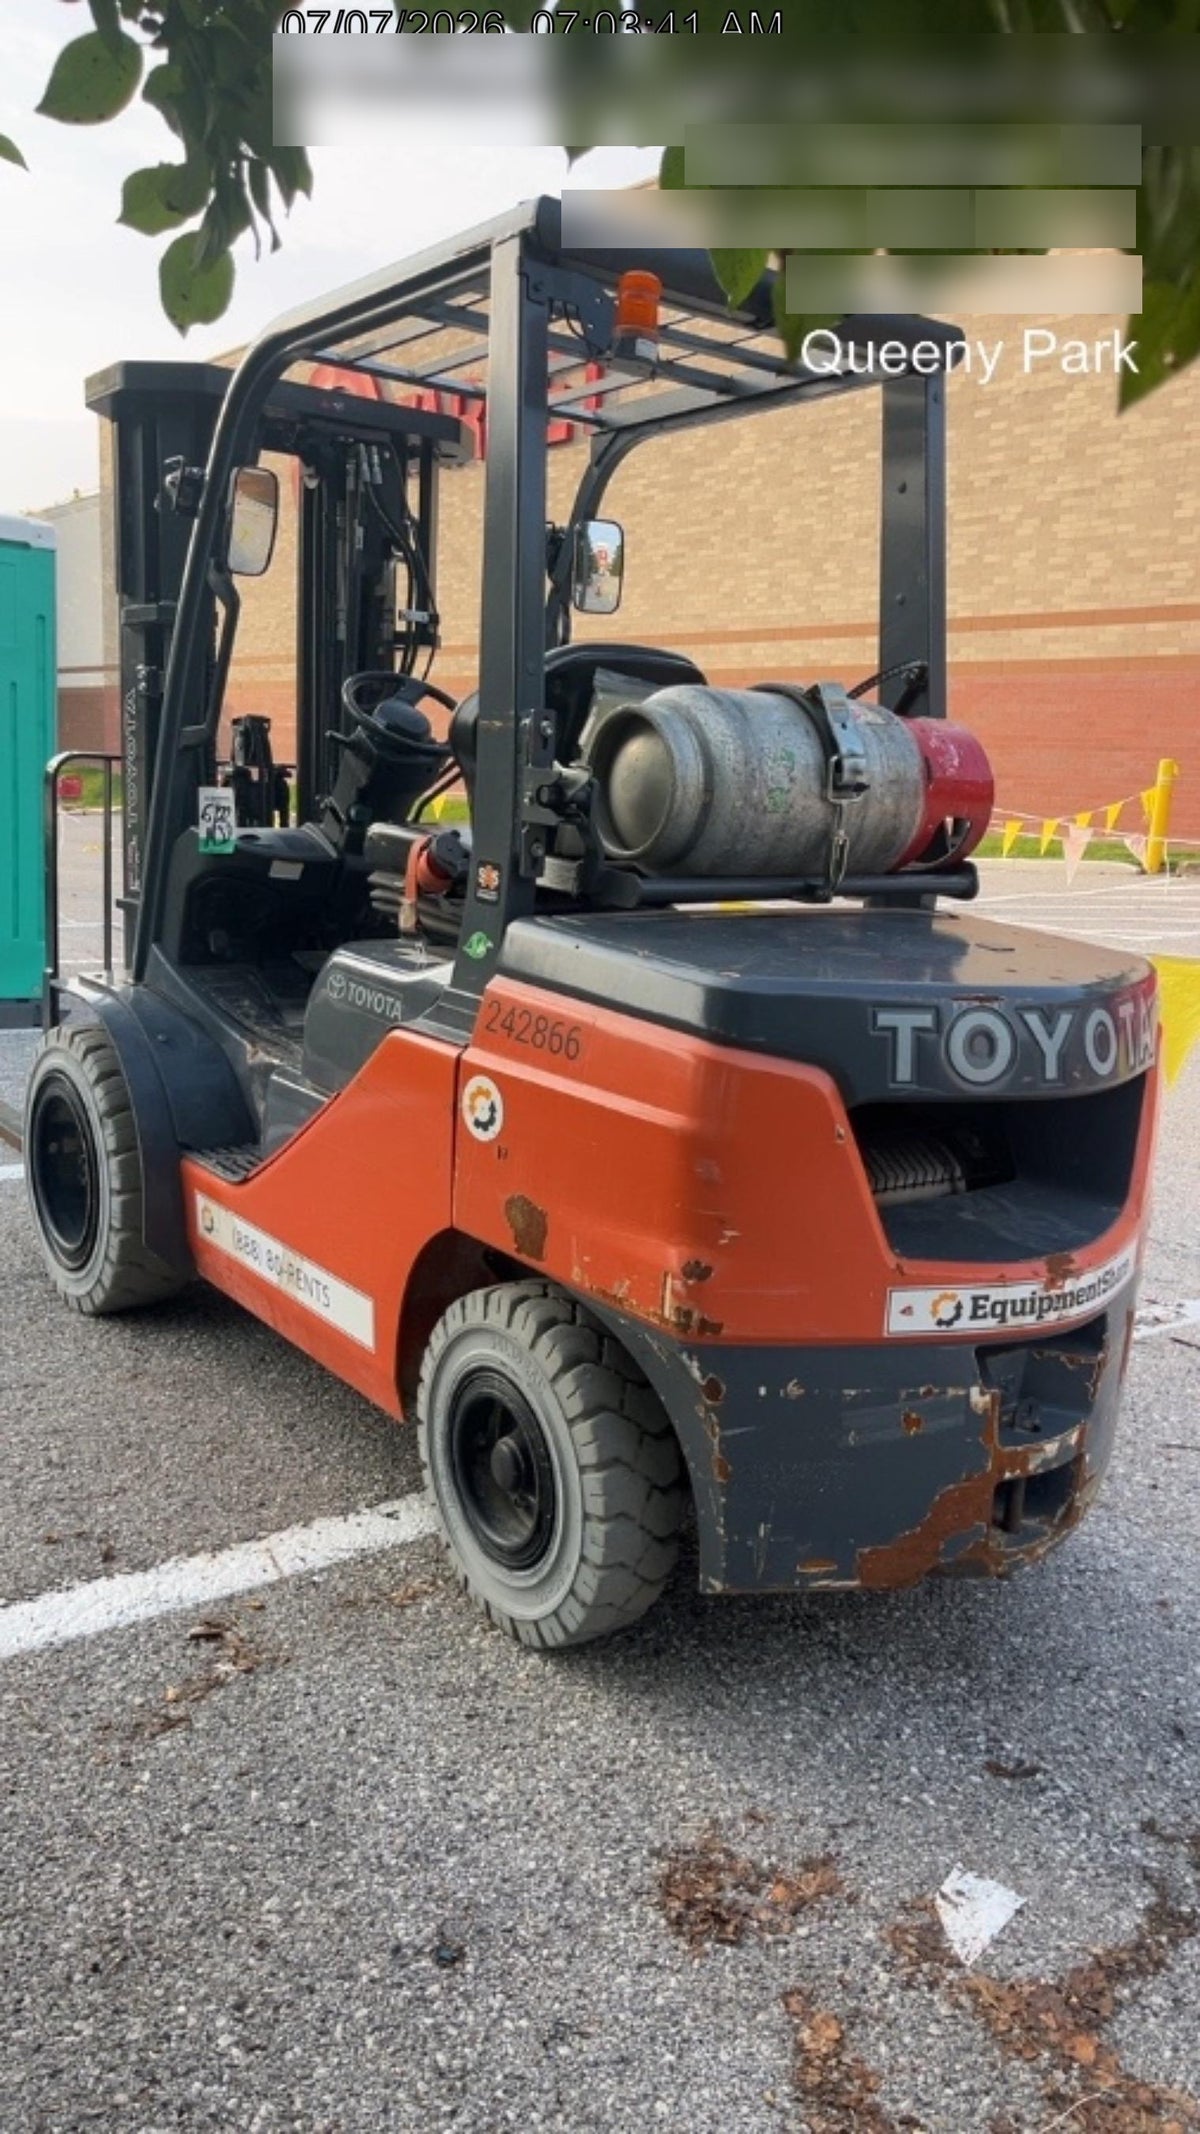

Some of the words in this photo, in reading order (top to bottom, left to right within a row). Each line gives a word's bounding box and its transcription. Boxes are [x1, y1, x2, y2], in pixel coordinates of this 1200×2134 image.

[348, 981, 402, 1021] TOYOTA
[485, 999, 583, 1061] 242866
[873, 996, 1157, 1084] TOYOTA
